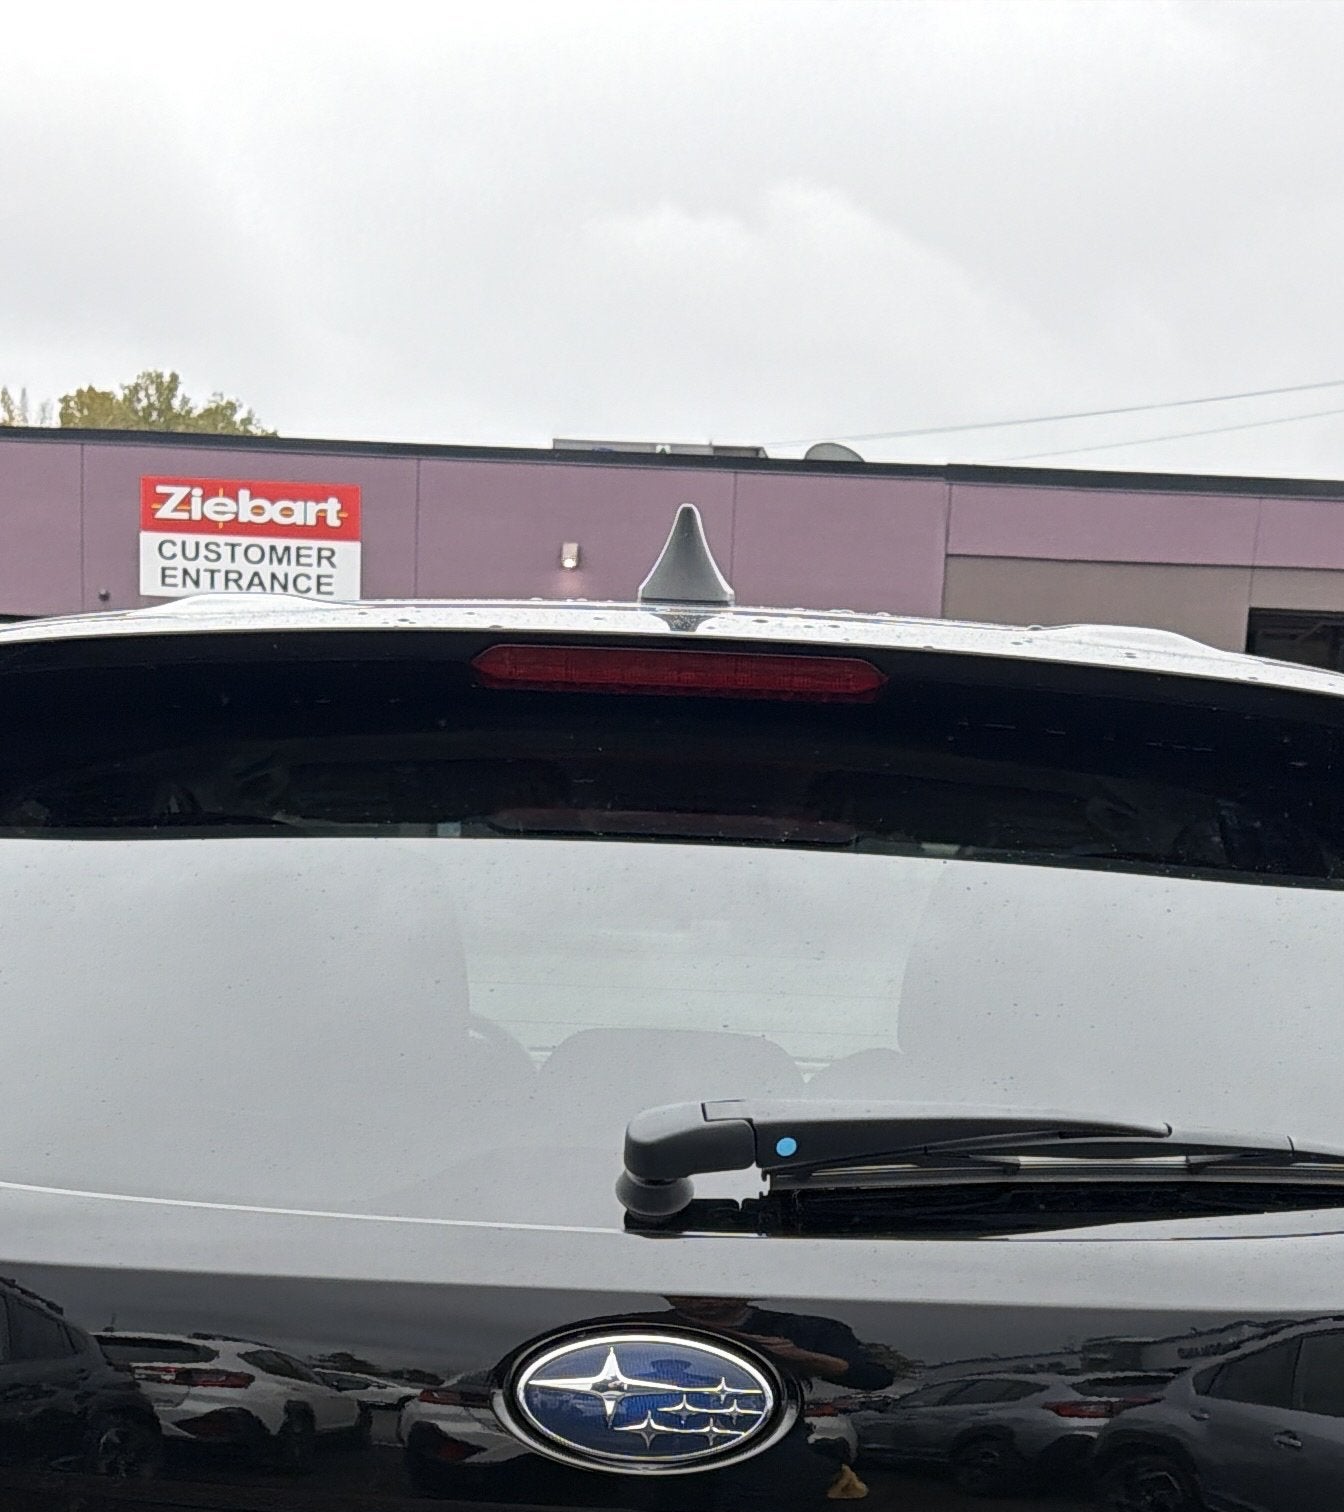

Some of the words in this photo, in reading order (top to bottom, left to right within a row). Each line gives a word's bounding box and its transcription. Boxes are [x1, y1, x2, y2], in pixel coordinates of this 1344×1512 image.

[154, 485, 342, 527] Ziebart
[158, 539, 337, 569] CUSTOMER
[161, 566, 335, 595] ENTRANCE
